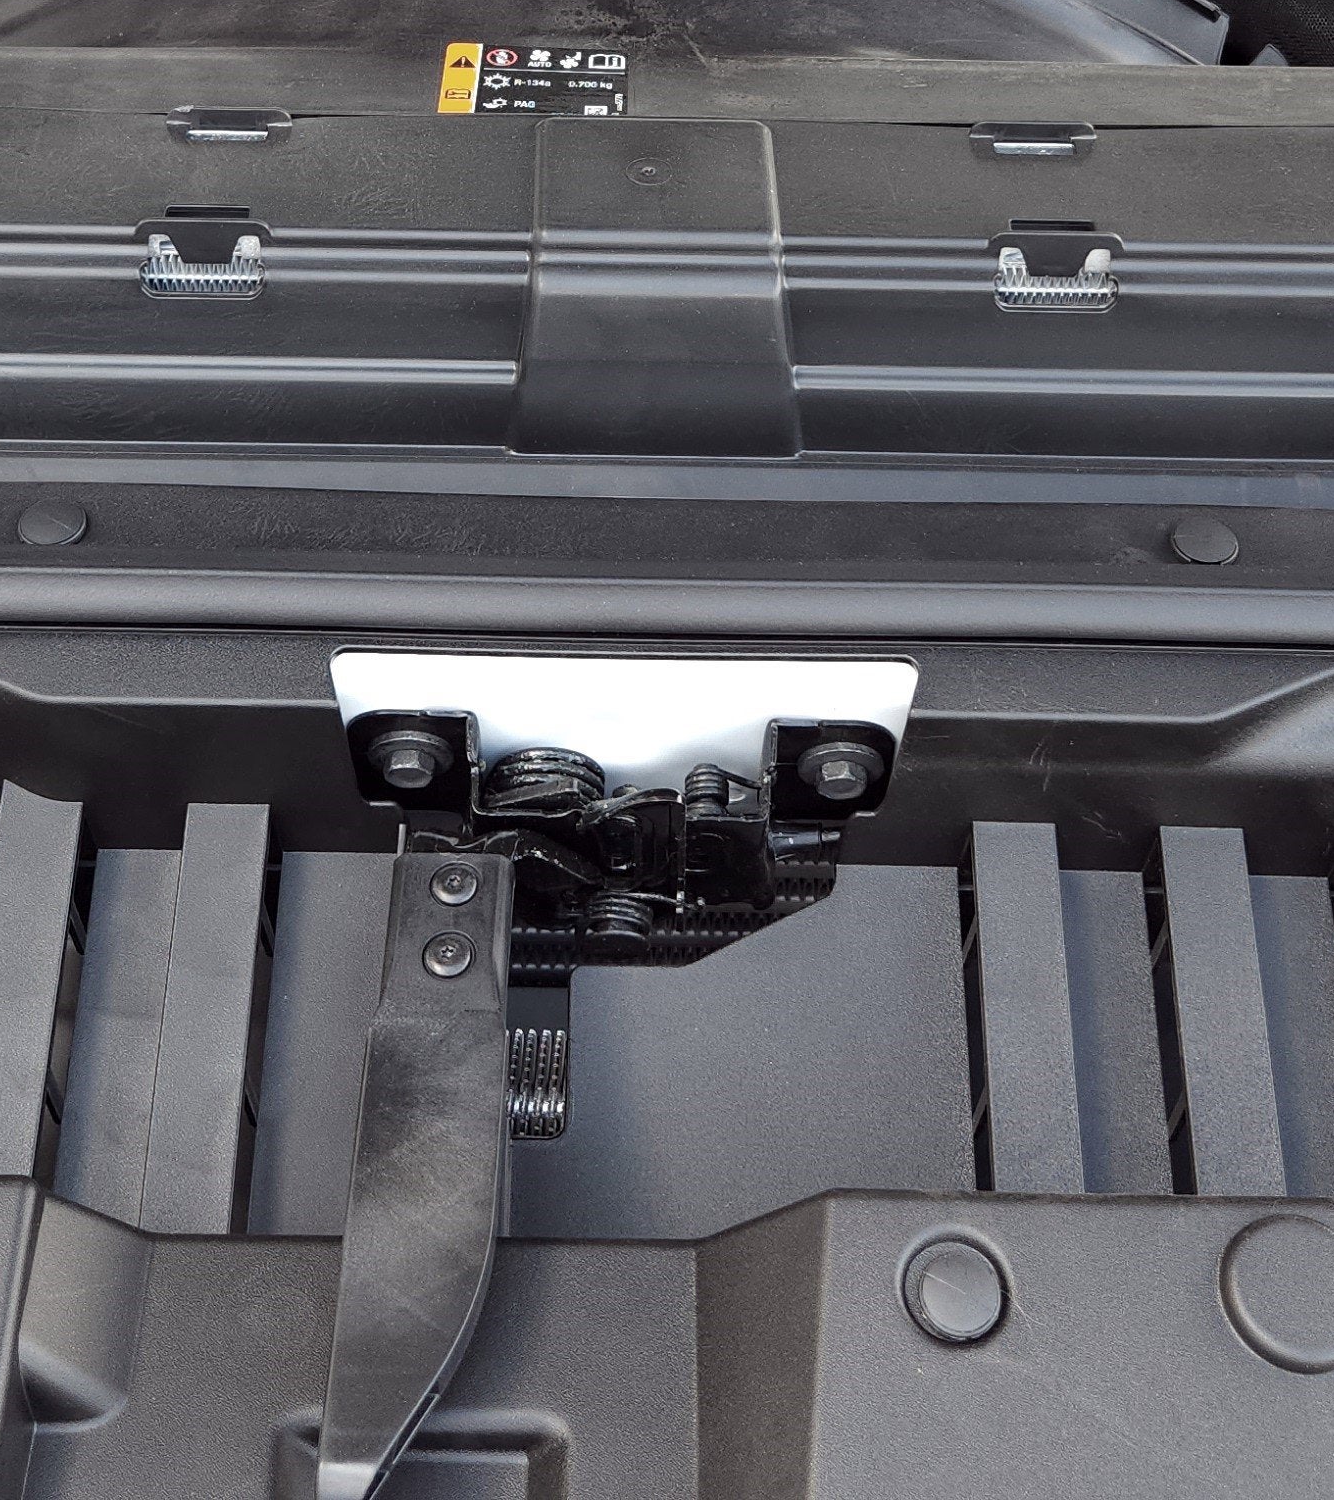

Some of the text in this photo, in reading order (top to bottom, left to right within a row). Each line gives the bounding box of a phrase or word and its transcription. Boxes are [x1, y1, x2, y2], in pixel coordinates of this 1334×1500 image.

[514, 79, 551, 87] R-134a
[599, 82, 613, 90] kg
[514, 100, 536, 108] PAG
